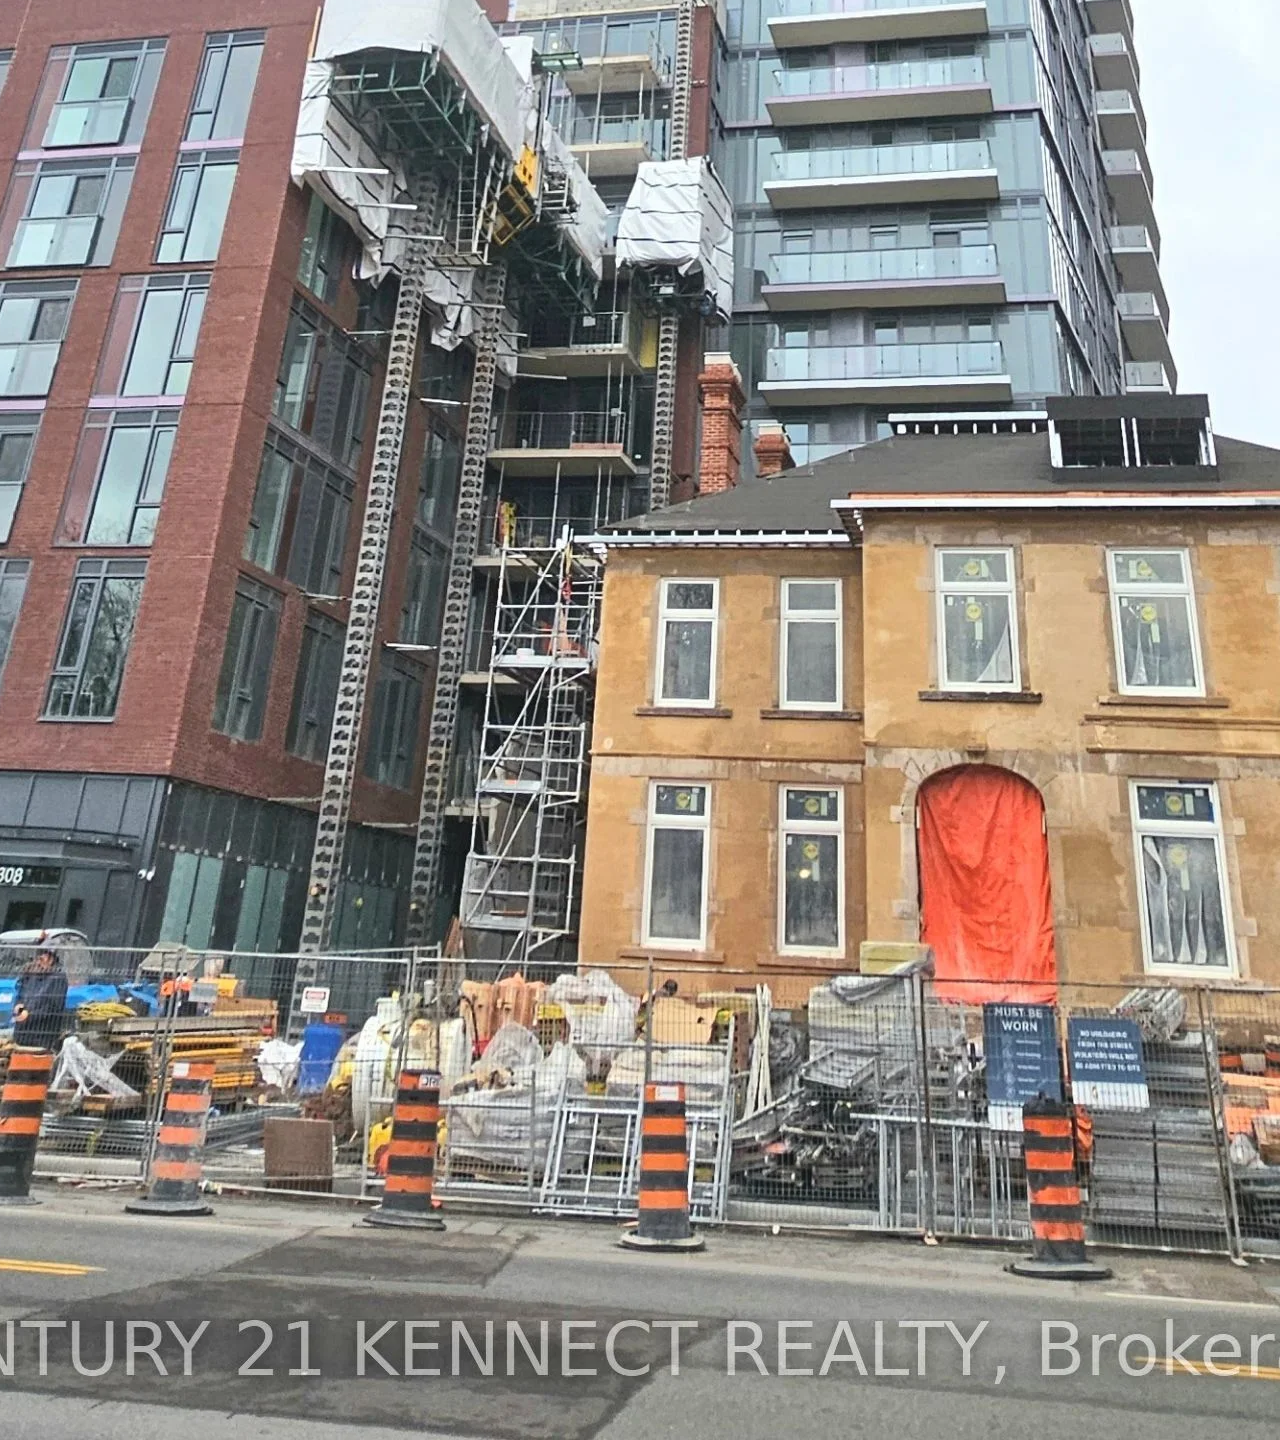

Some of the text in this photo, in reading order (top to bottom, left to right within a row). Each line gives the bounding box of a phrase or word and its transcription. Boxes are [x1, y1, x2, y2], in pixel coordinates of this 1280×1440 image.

[994, 1007, 1043, 1018] MUST BE
[1001, 1020, 1038, 1032] WORN
